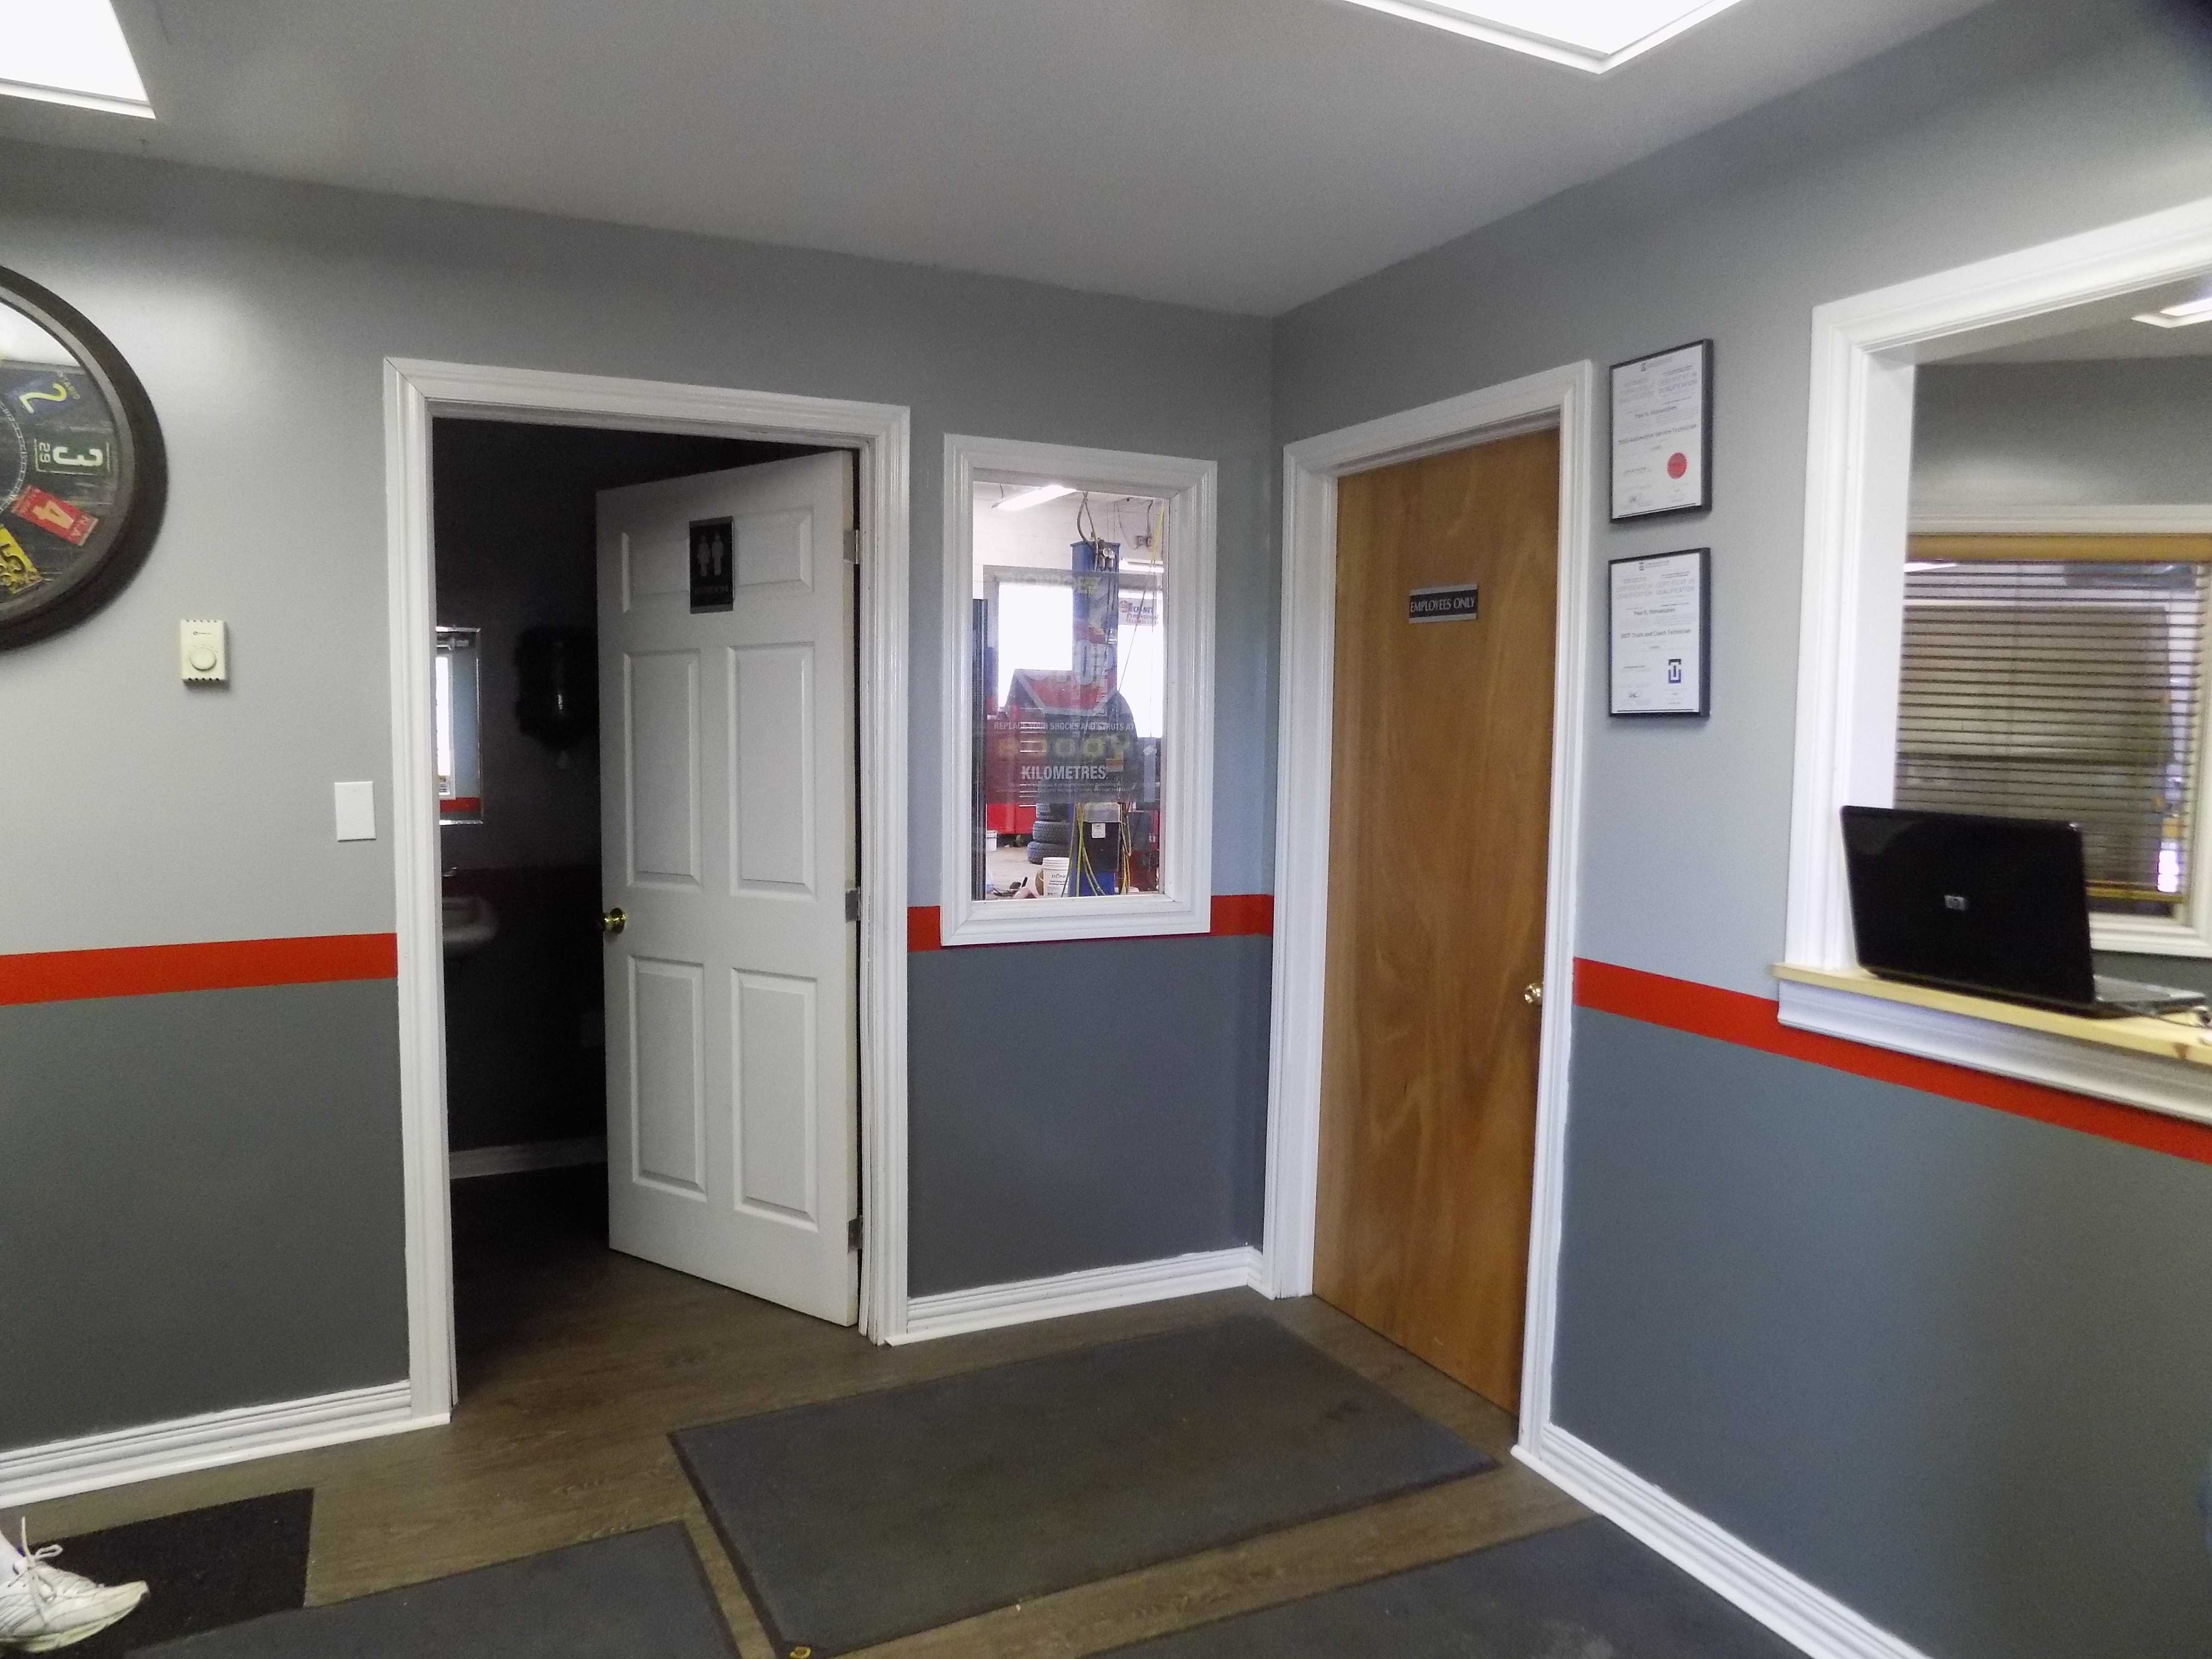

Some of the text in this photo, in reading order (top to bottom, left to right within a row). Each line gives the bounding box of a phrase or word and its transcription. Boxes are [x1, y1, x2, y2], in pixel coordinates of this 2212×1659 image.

[19, 383, 67, 414] 2
[39, 442, 51, 463] 29
[53, 446, 104, 467] 3
[32, 500, 74, 529] 4
[1410, 597, 1475, 612] EMPLOYEES ONLY
[1050, 722, 1080, 730] SHOCKS
[1081, 722, 1095, 730] AND
